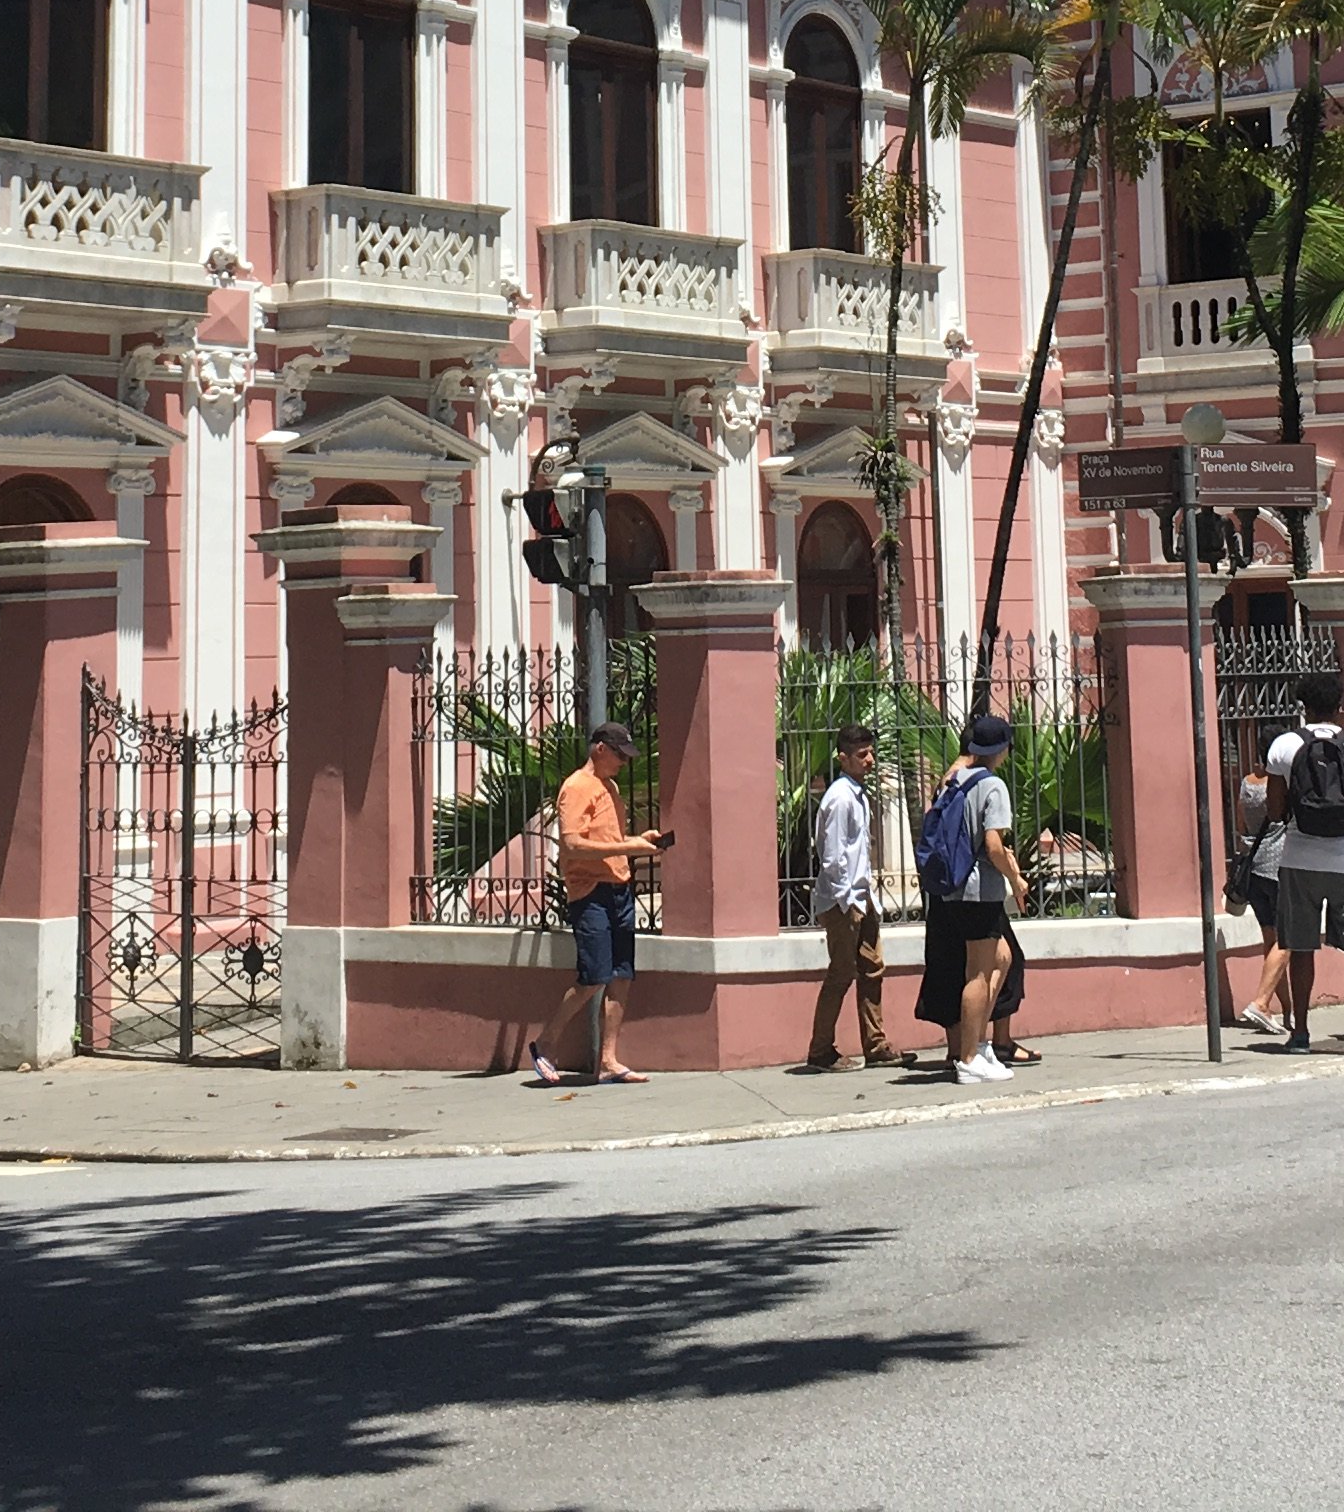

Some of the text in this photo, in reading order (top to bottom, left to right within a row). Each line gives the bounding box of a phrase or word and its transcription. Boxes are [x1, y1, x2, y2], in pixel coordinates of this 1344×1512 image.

[1200, 447, 1224, 459] Rua
[1081, 454, 1109, 466] Praça
[1083, 464, 1163, 478] XV de Novembro
[1201, 460, 1294, 473] Tenente Silveira
[1084, 500, 1101, 510] 151
[1104, 501, 1111, 509] a
